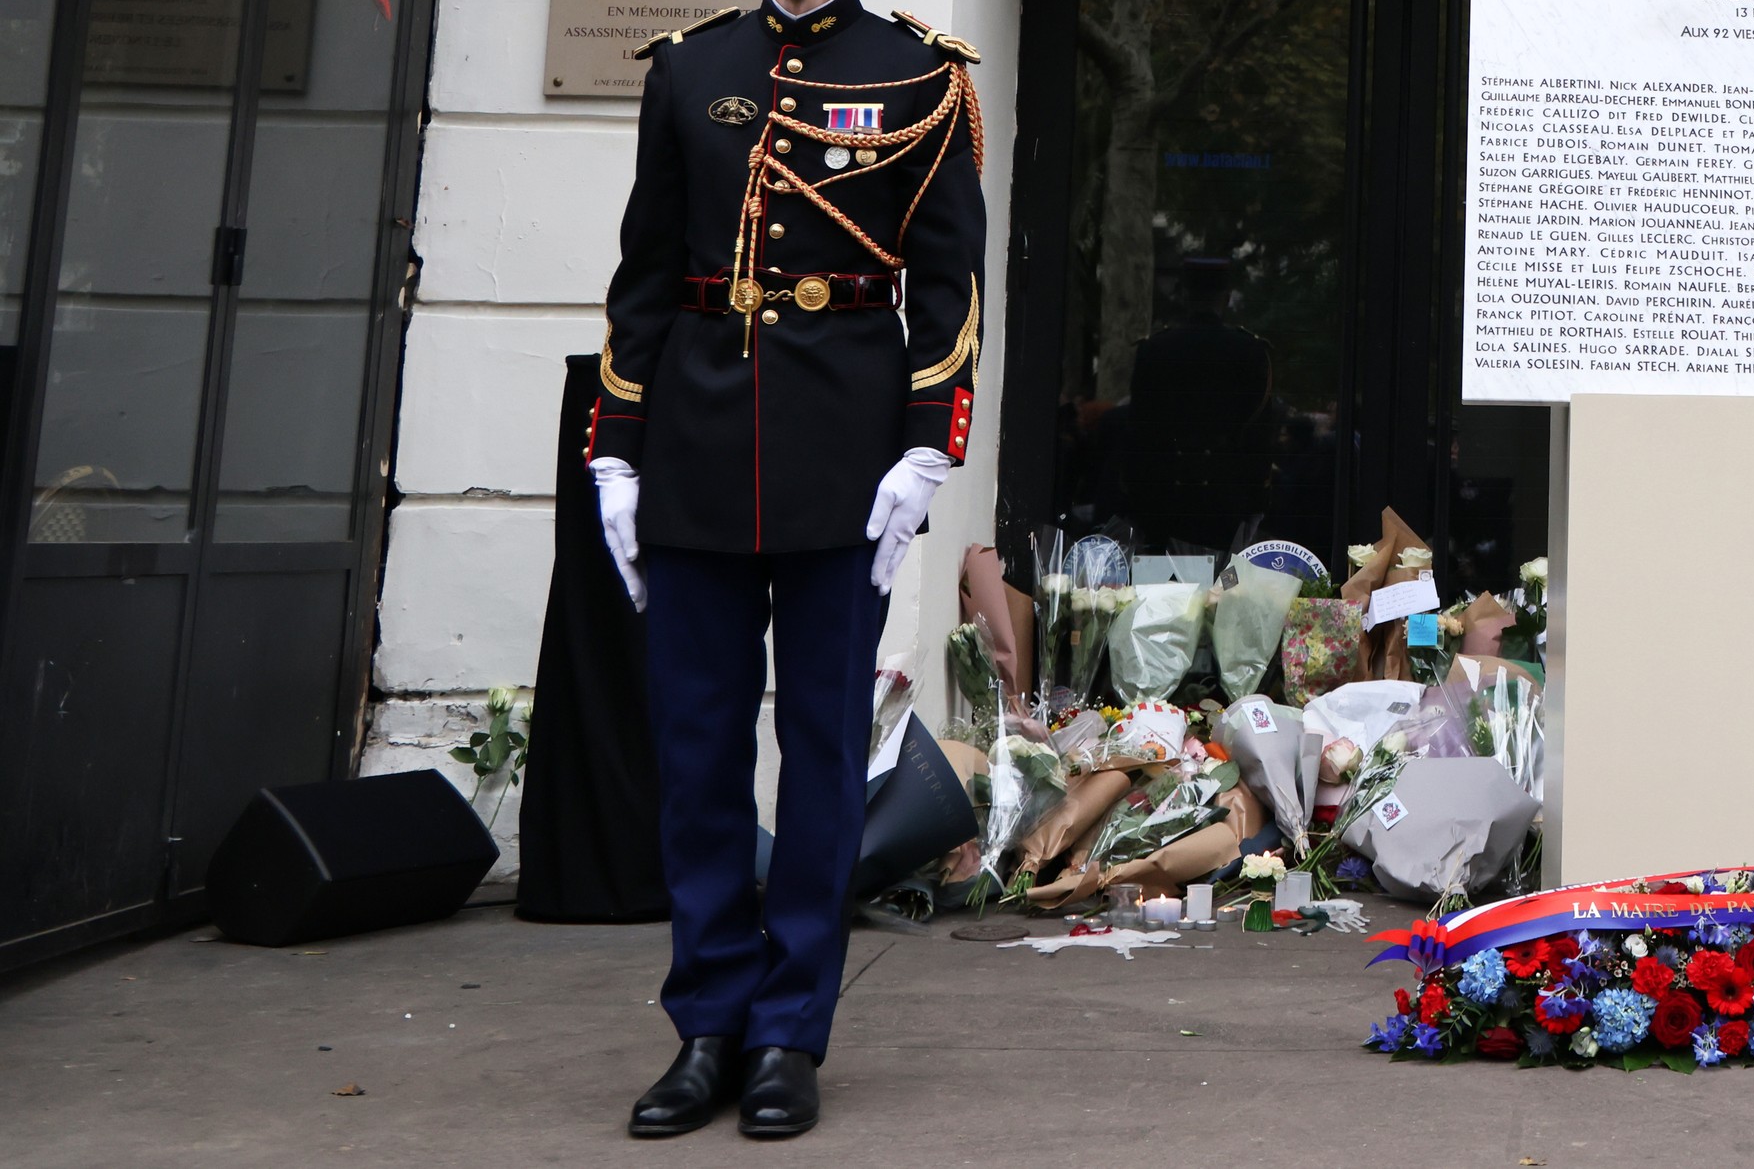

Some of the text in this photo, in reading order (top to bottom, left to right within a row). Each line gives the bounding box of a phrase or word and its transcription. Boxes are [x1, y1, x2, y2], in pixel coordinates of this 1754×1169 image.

[607, 6, 626, 17] EN
[628, 4, 690, 18] MÉMOIRE
[694, 8, 718, 18] DES
[1735, 6, 1749, 18] 13
[564, 25, 647, 39] ASSASSINÉES
[1712, 27, 1730, 39] 92
[594, 79, 610, 87] UNE
[1539, 77, 1605, 91] ALBERTINI.
[1642, 81, 1718, 94] ALEXANDER.
[1545, 92, 1658, 107] BARREAU-DECHERF.
[1536, 137, 1592, 150] DUBOIS.
[1657, 140, 1707, 154] DUNET.
[1521, 167, 1594, 181] GARRIGUES.
[1641, 170, 1700, 184] GAUBERT.
[1548, 230, 1592, 242] GUEN.
[1640, 232, 1696, 245] LECLERC.
[1545, 245, 1591, 258] MARY.
[1656, 248, 1729, 262] MAUDUIT.
[1524, 276, 1618, 291] MUYAL-LEIRIS.
[1677, 281, 1731, 294] NAUFLE.
[1526, 357, 1585, 371] SOLESIN.
[1636, 360, 1680, 373] STECH.
[1572, 901, 1602, 920] LA
[1610, 900, 1680, 919] MAIRE
[1689, 901, 1717, 917] DE
